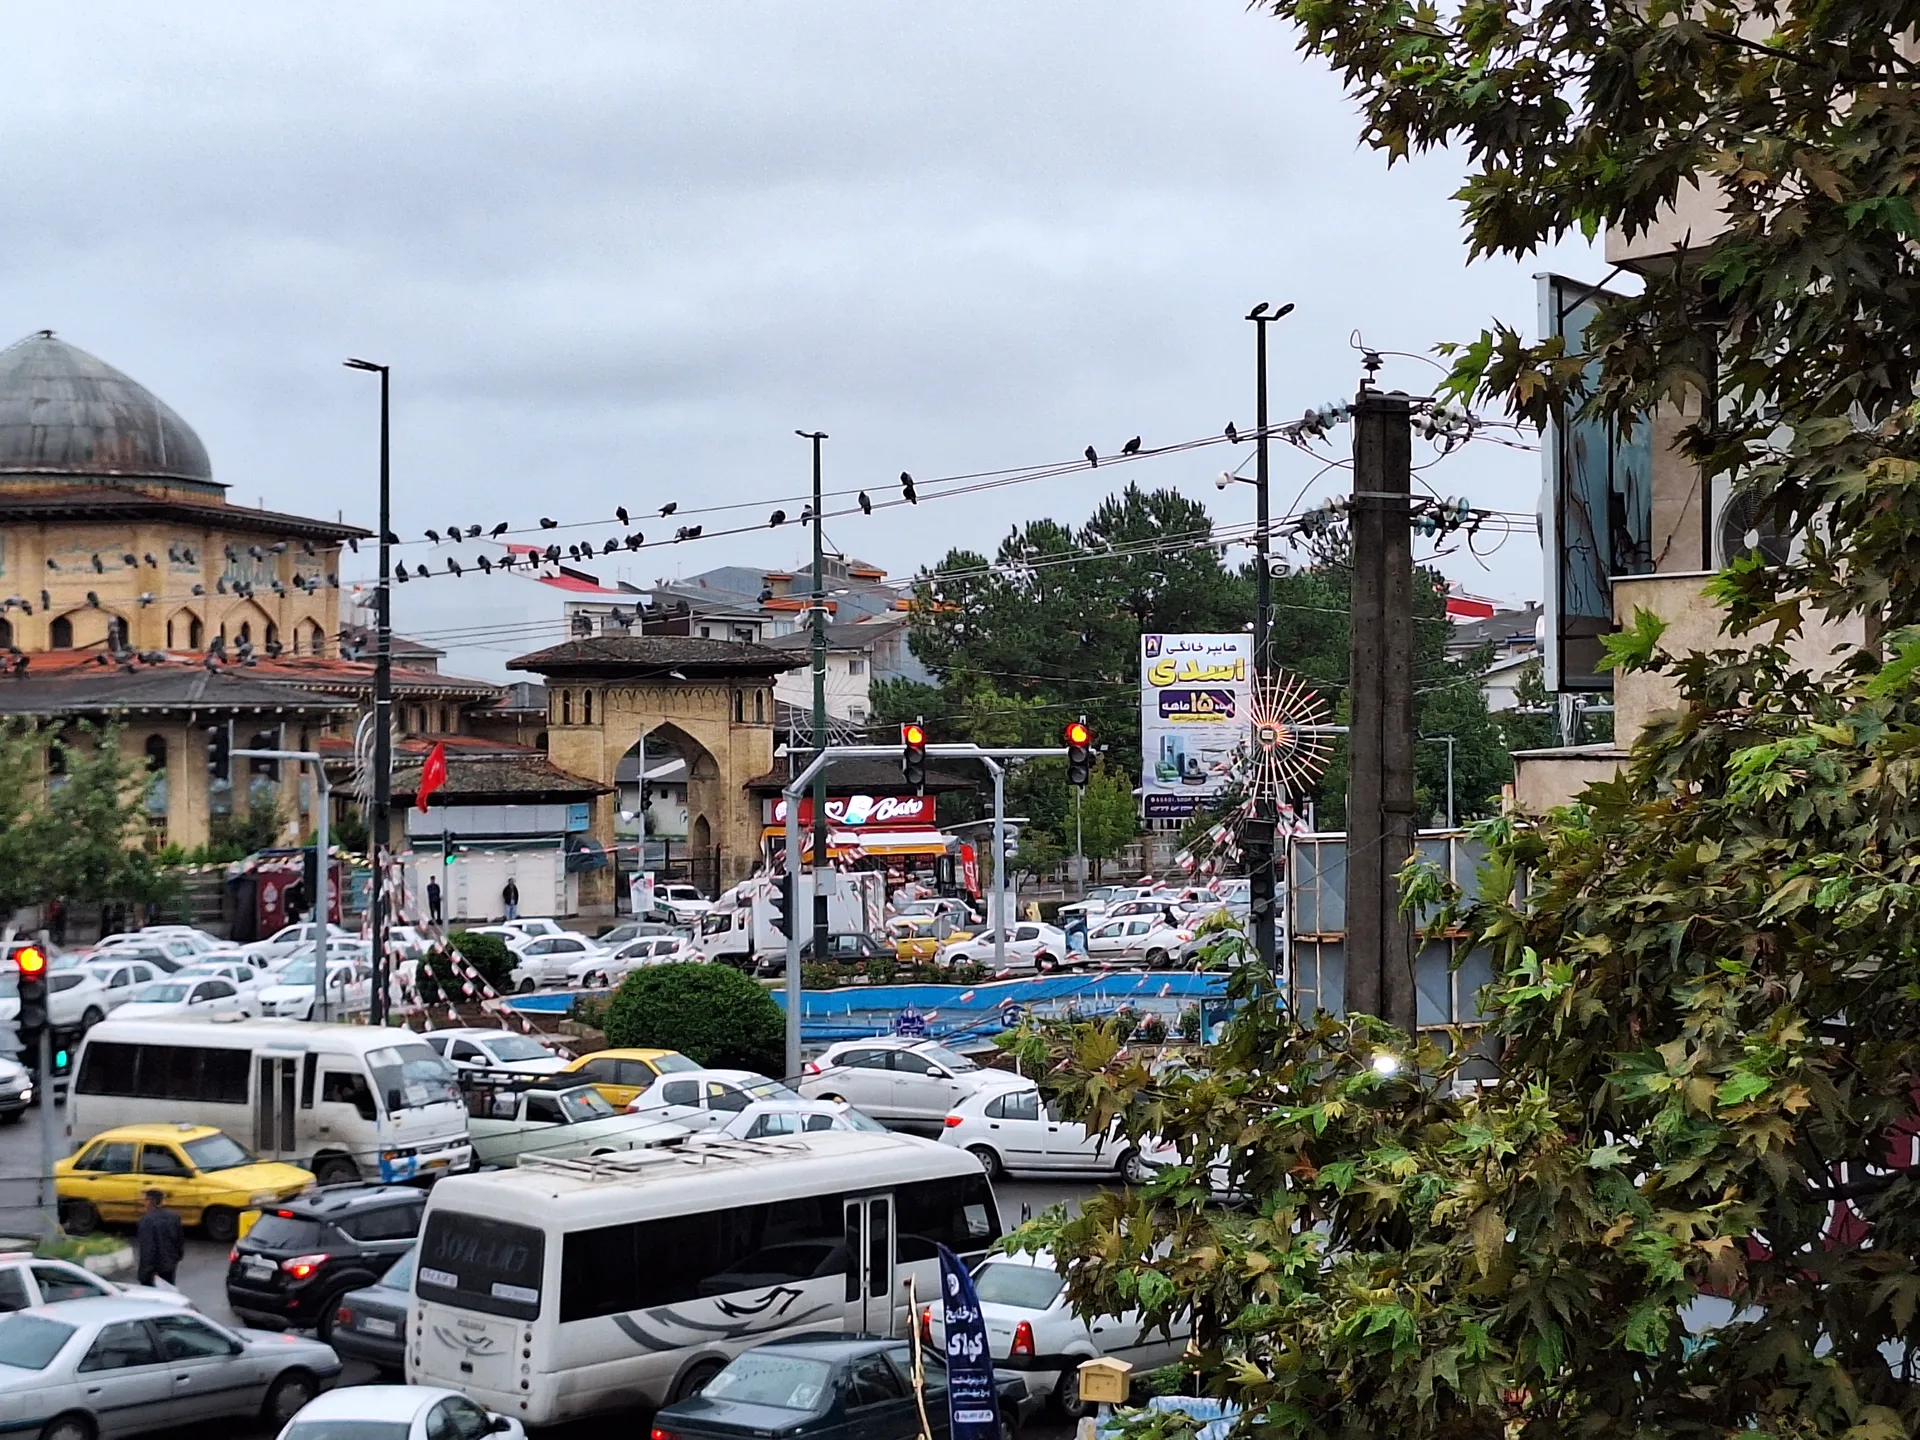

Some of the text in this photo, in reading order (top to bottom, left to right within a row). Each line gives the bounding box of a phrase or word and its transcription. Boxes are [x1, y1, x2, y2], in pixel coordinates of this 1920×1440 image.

[1166, 640, 1204, 655] خانگی
[1205, 642, 1237, 657] هایپر
[1148, 657, 1245, 687] اسدی
[1162, 700, 1190, 711] ماهه
